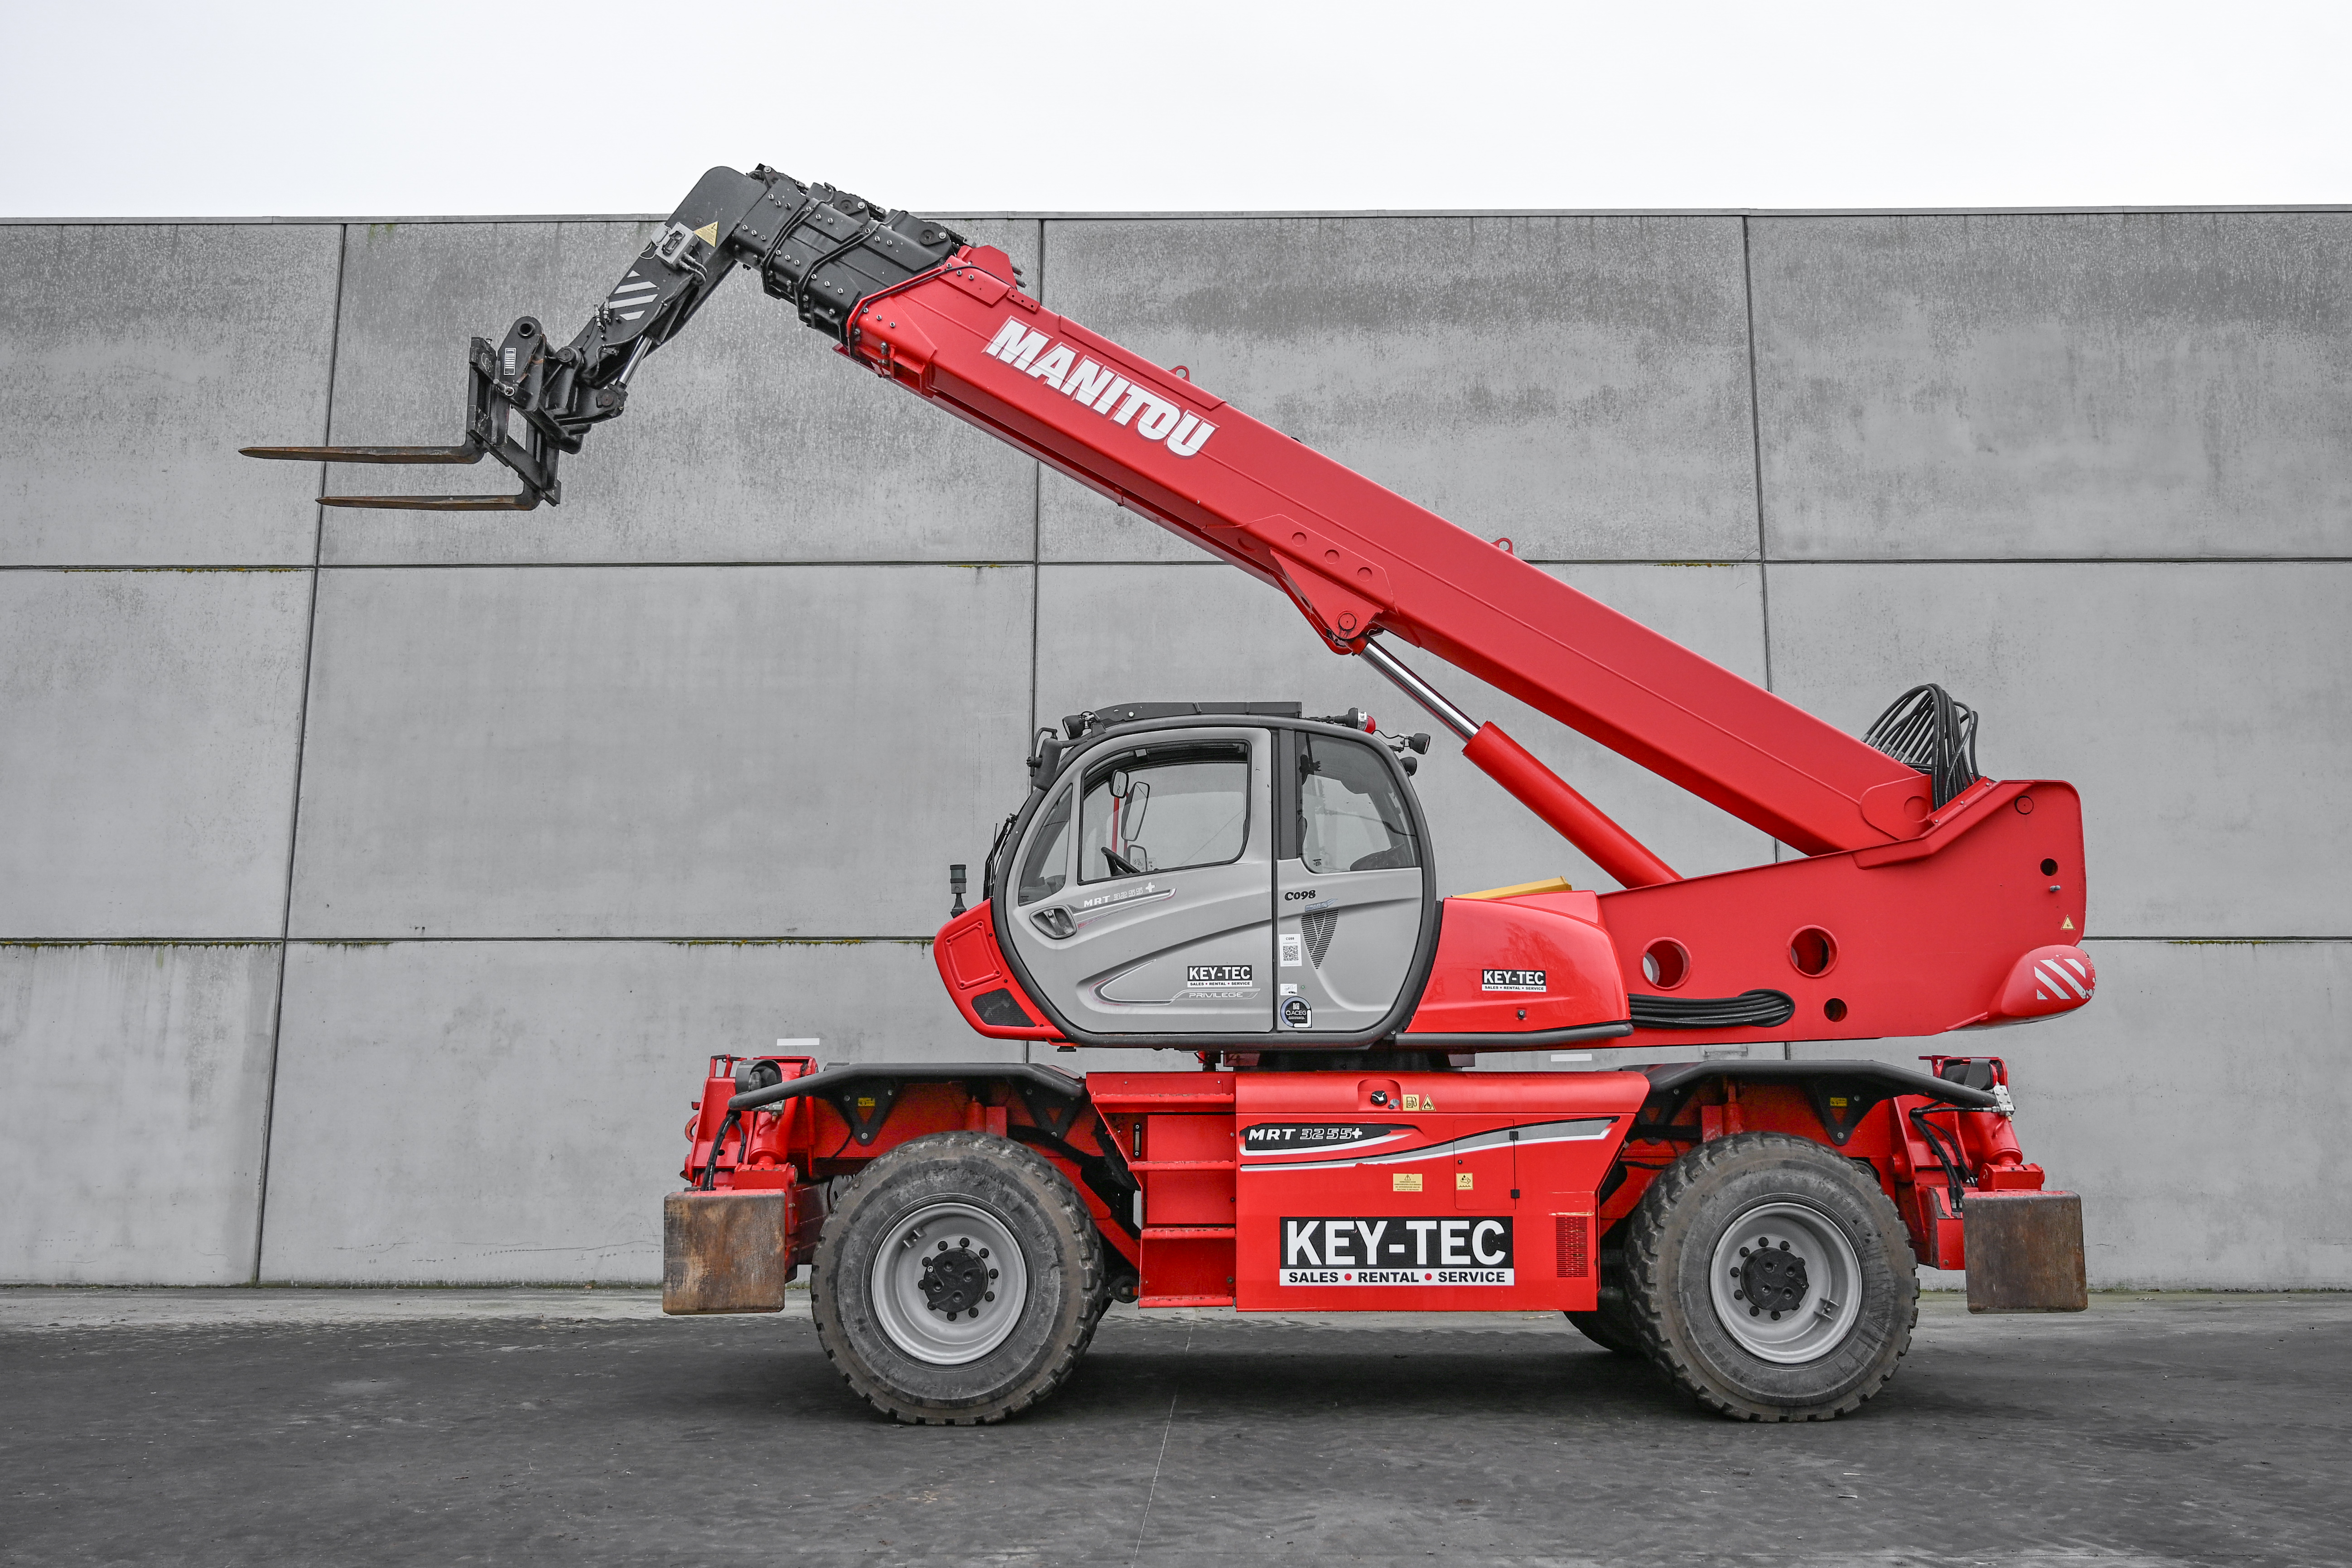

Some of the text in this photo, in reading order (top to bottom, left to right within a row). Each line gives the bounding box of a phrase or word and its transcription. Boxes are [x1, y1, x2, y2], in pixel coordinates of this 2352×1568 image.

[984, 317, 1217, 458] MANITOU
[1084, 895, 1110, 907] MRT
[1284, 890, 1316, 901] C098
[1189, 966, 1250, 980] KEY-TEC
[1484, 970, 1544, 984] KEY-TEC
[1248, 1129, 1296, 1141] MRT
[1287, 1220, 1506, 1265] KEY-TEC
[1289, 1271, 1505, 1283] SALES RENTAL SERVICE
